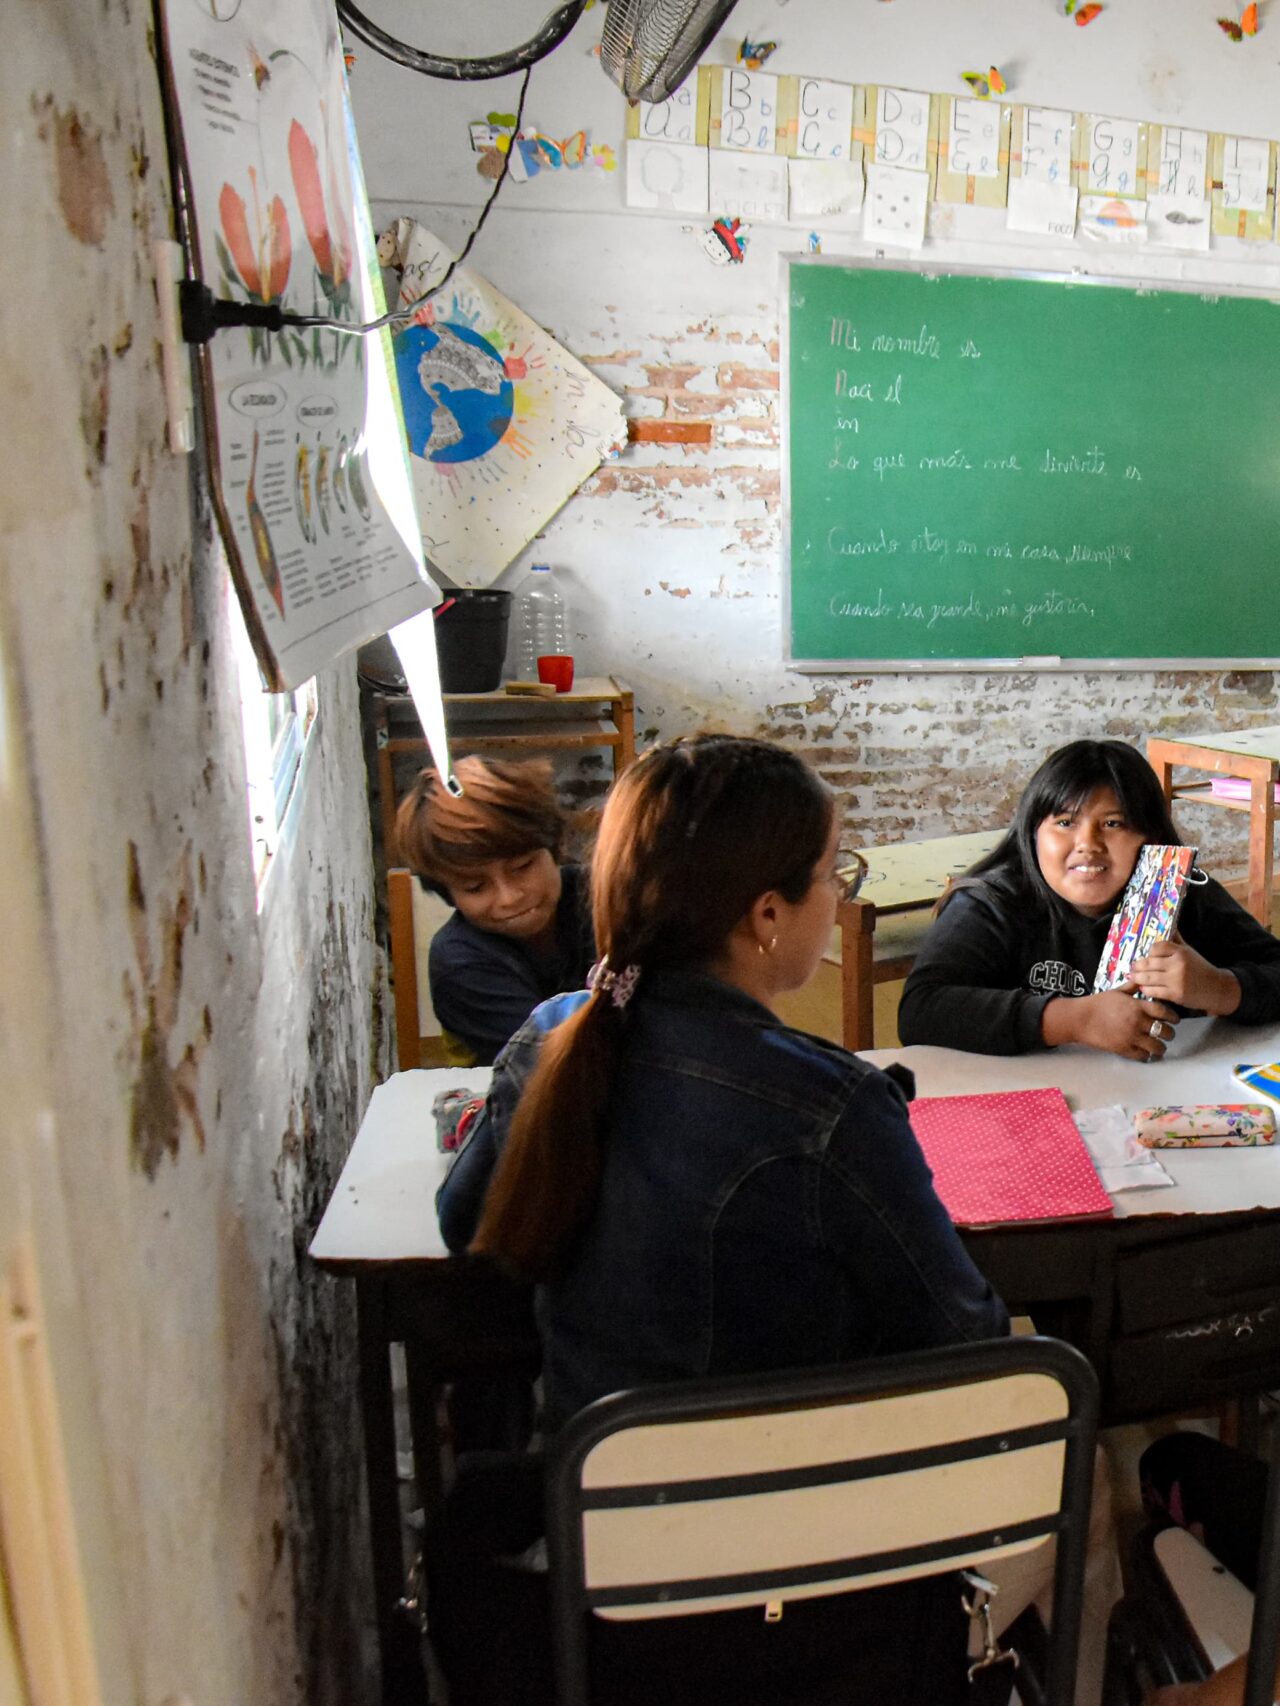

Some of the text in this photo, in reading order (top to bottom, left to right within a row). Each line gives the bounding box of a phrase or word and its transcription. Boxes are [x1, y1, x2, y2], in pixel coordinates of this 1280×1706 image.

[729, 70, 773, 116] B b
[802, 80, 820, 118] C
[883, 89, 903, 123] D
[724, 108, 752, 147] B
[953, 98, 971, 134] E
[1026, 107, 1043, 142] F
[1093, 120, 1114, 152] G
[1164, 128, 1183, 161] H
[830, 316, 861, 352] Mi
[872, 324, 940, 359] nombre
[872, 453, 906, 482] que
[827, 527, 900, 556] Cuando
[829, 588, 893, 618] Cuando
